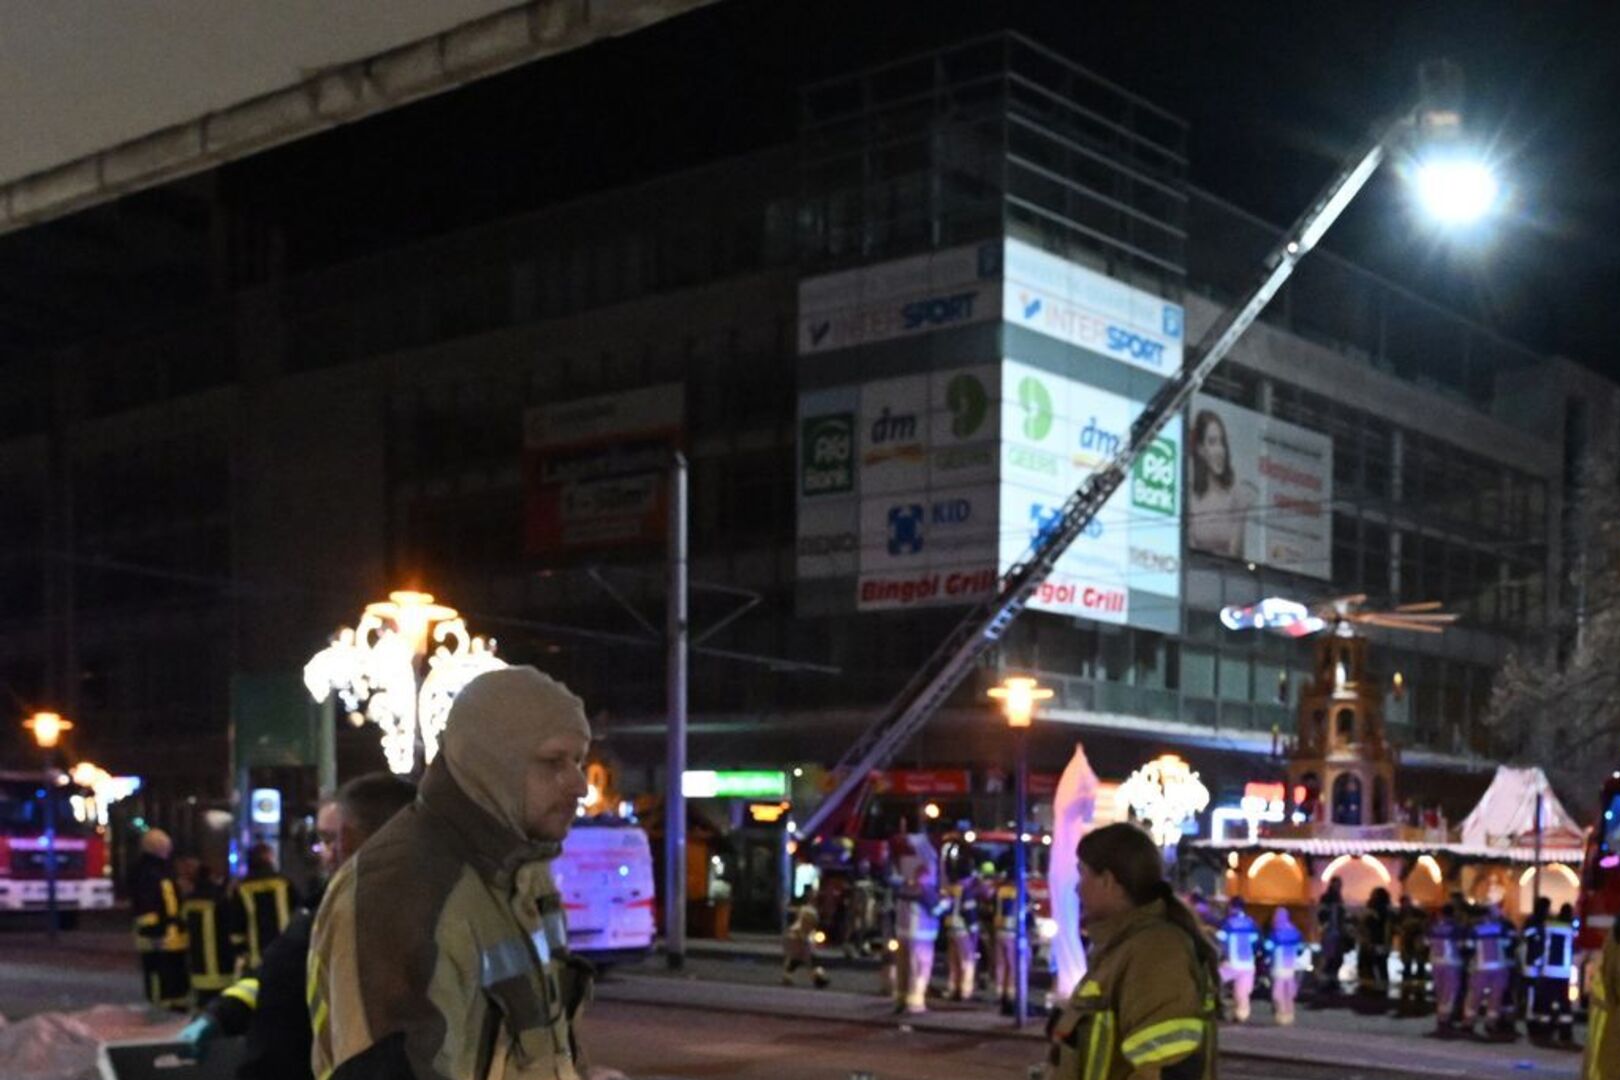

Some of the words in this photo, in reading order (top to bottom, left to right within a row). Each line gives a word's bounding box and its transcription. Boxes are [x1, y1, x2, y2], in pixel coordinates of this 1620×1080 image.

[1045, 300, 1166, 368] INTERSPORT
[871, 406, 917, 444] dm
[1081, 417, 1119, 456] dm
[932, 499, 970, 524] KID
[1082, 586, 1125, 613] Grill
